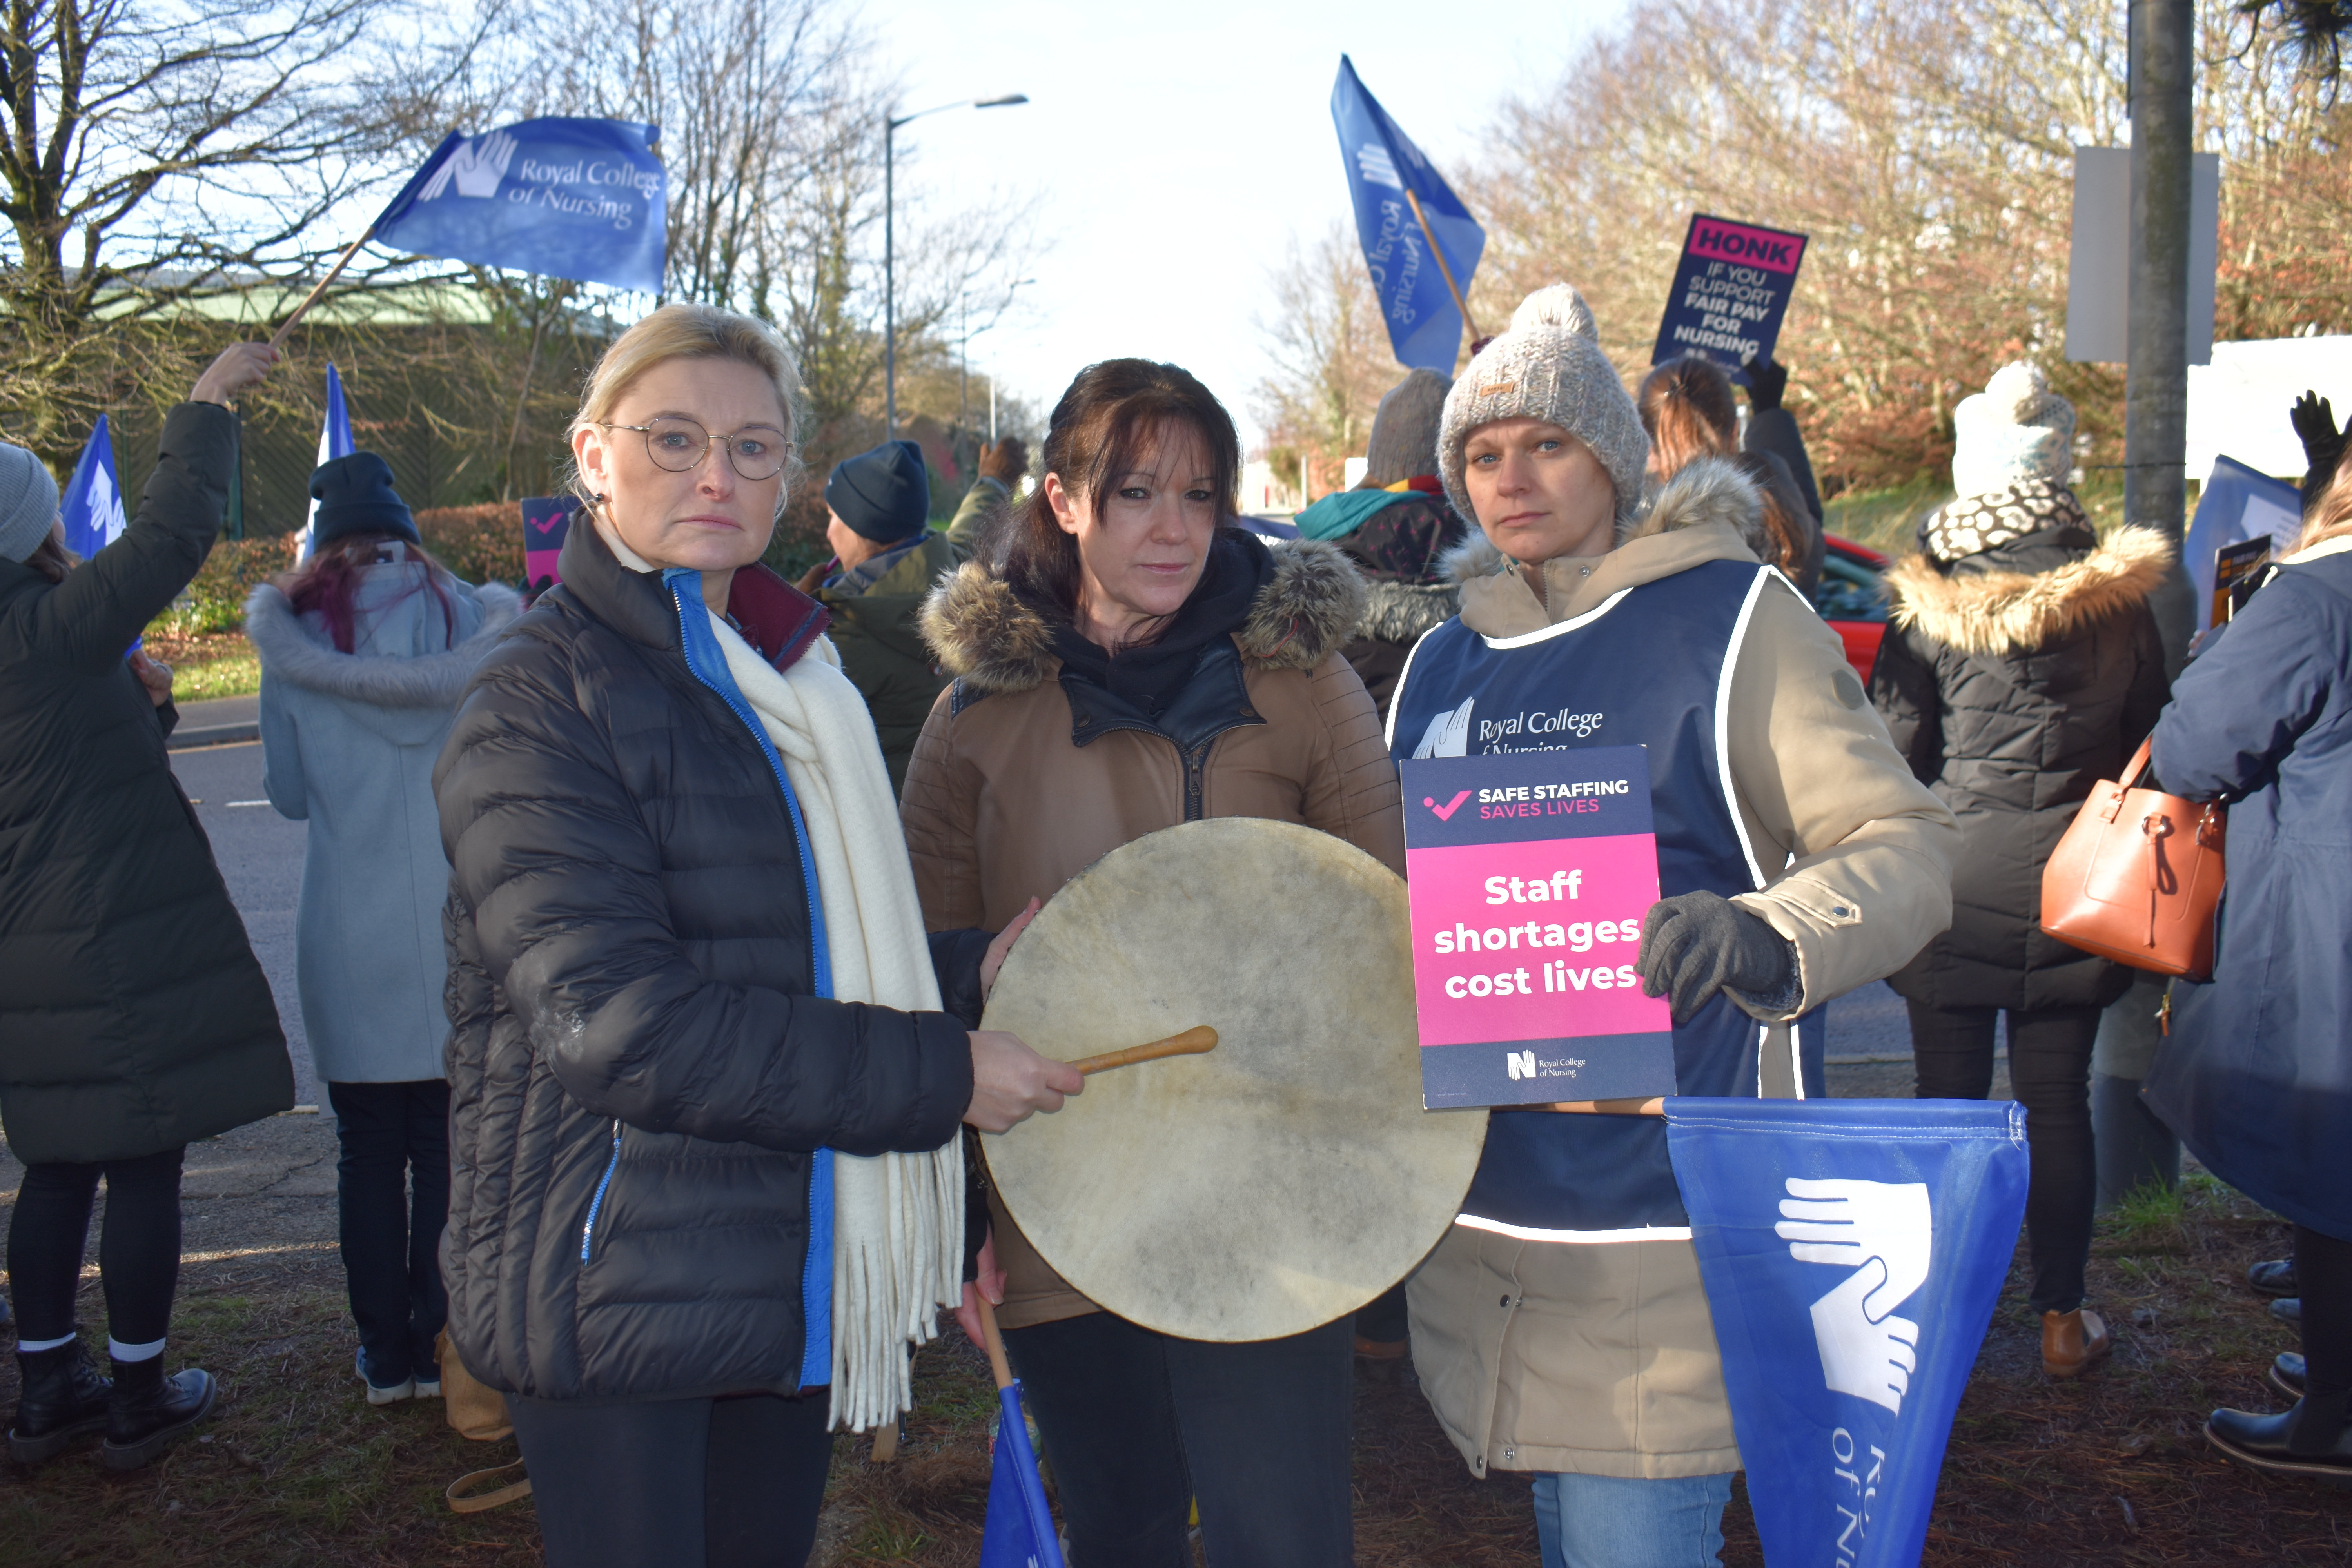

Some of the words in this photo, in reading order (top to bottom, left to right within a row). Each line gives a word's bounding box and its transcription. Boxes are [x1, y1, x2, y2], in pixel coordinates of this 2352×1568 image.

[520, 158, 583, 189] Royal
[508, 186, 541, 204] of
[539, 187, 632, 230] Nursing
[1697, 228, 1794, 265] HONK
[1706, 261, 1726, 277] IF
[1728, 265, 1767, 287] YOU
[1688, 276, 1776, 305] SUPPORT
[1684, 293, 1730, 314] FAIR
[1730, 302, 1770, 322] PAY
[1701, 314, 1742, 334] FOR
[1673, 325, 1760, 355] NURSING
[1479, 711, 1524, 744] Royal
[1528, 708, 1603, 738] College
[1479, 786, 1529, 803] SAFE
[1534, 780, 1629, 800] STAFFING
[1480, 802, 1541, 820] SAVES
[1547, 799, 1600, 815] LIVES
[1485, 869, 1582, 905] Staff
[1434, 918, 1641, 954] shortages
[1445, 967, 1532, 998] cost
[1543, 960, 1637, 993] lives
[1539, 1059, 1558, 1069] Royal
[1560, 1058, 1586, 1067] College
[1549, 1068, 1576, 1078] Nursing
[1832, 1426, 1860, 1497] of
